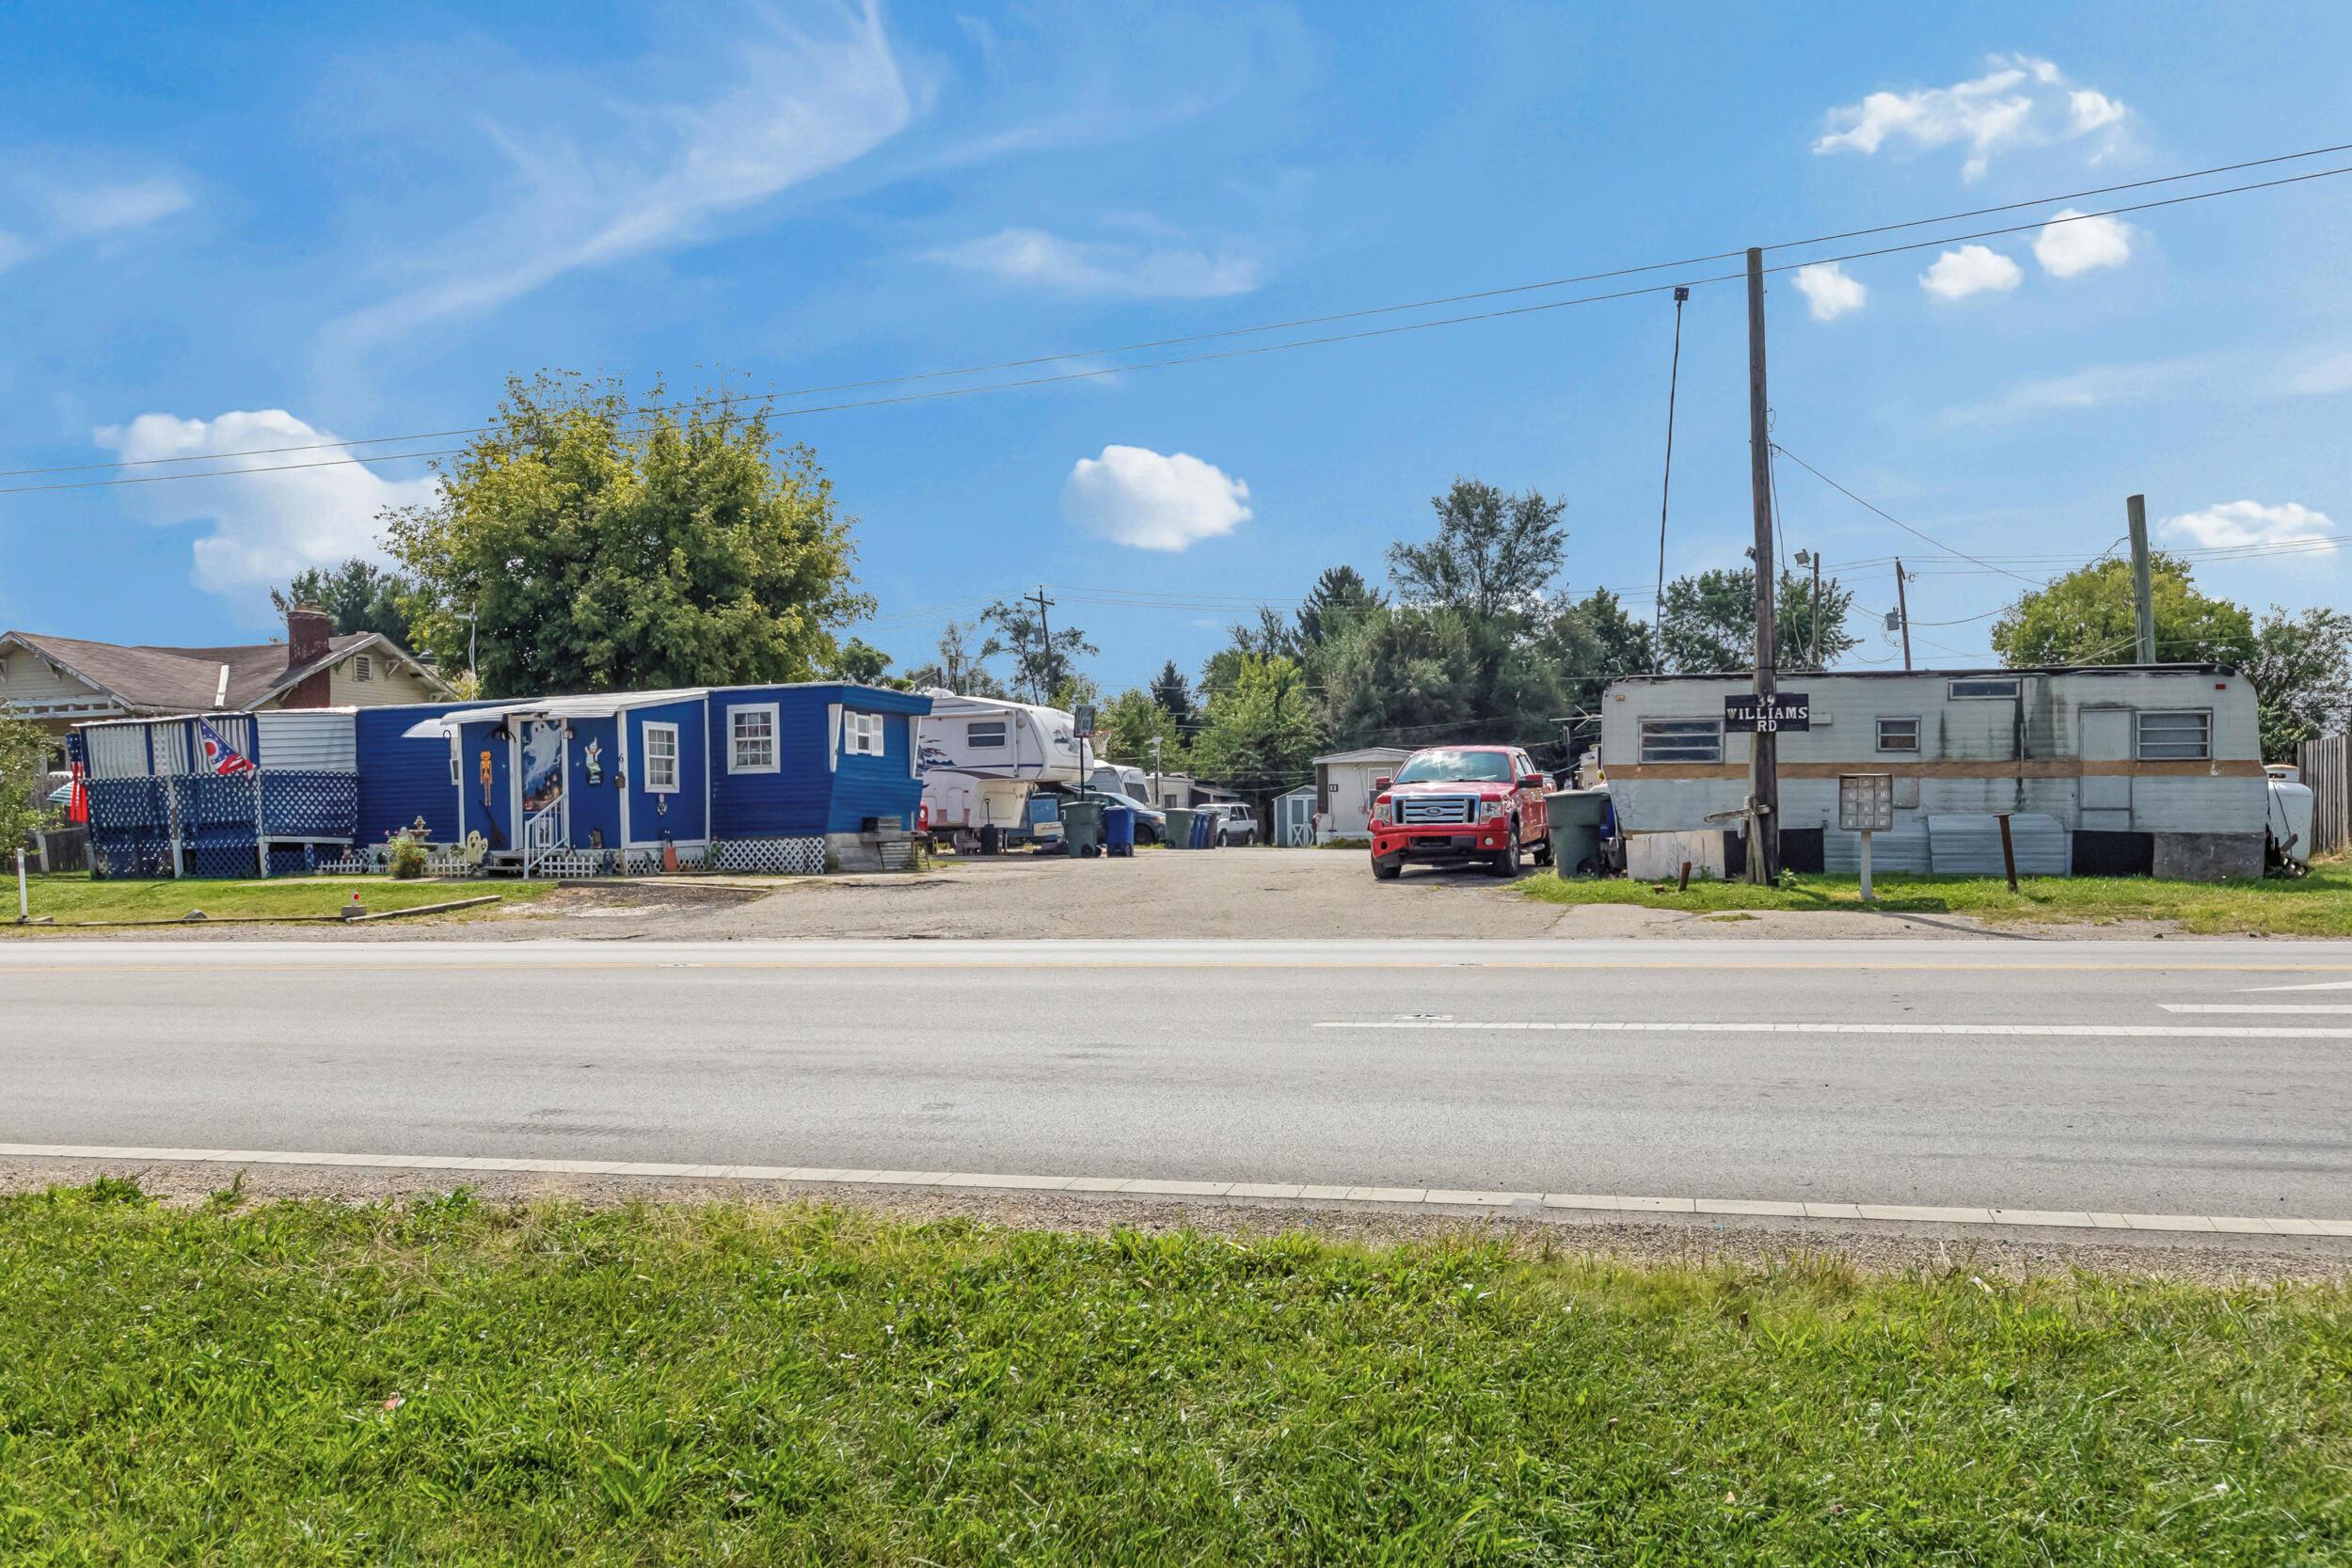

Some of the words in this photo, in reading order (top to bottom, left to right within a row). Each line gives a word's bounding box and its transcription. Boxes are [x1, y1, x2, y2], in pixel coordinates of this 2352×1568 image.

[1756, 694, 1775, 707] 39
[1726, 706, 1808, 720] WILLIAMS
[1756, 720, 1777, 732] RD
